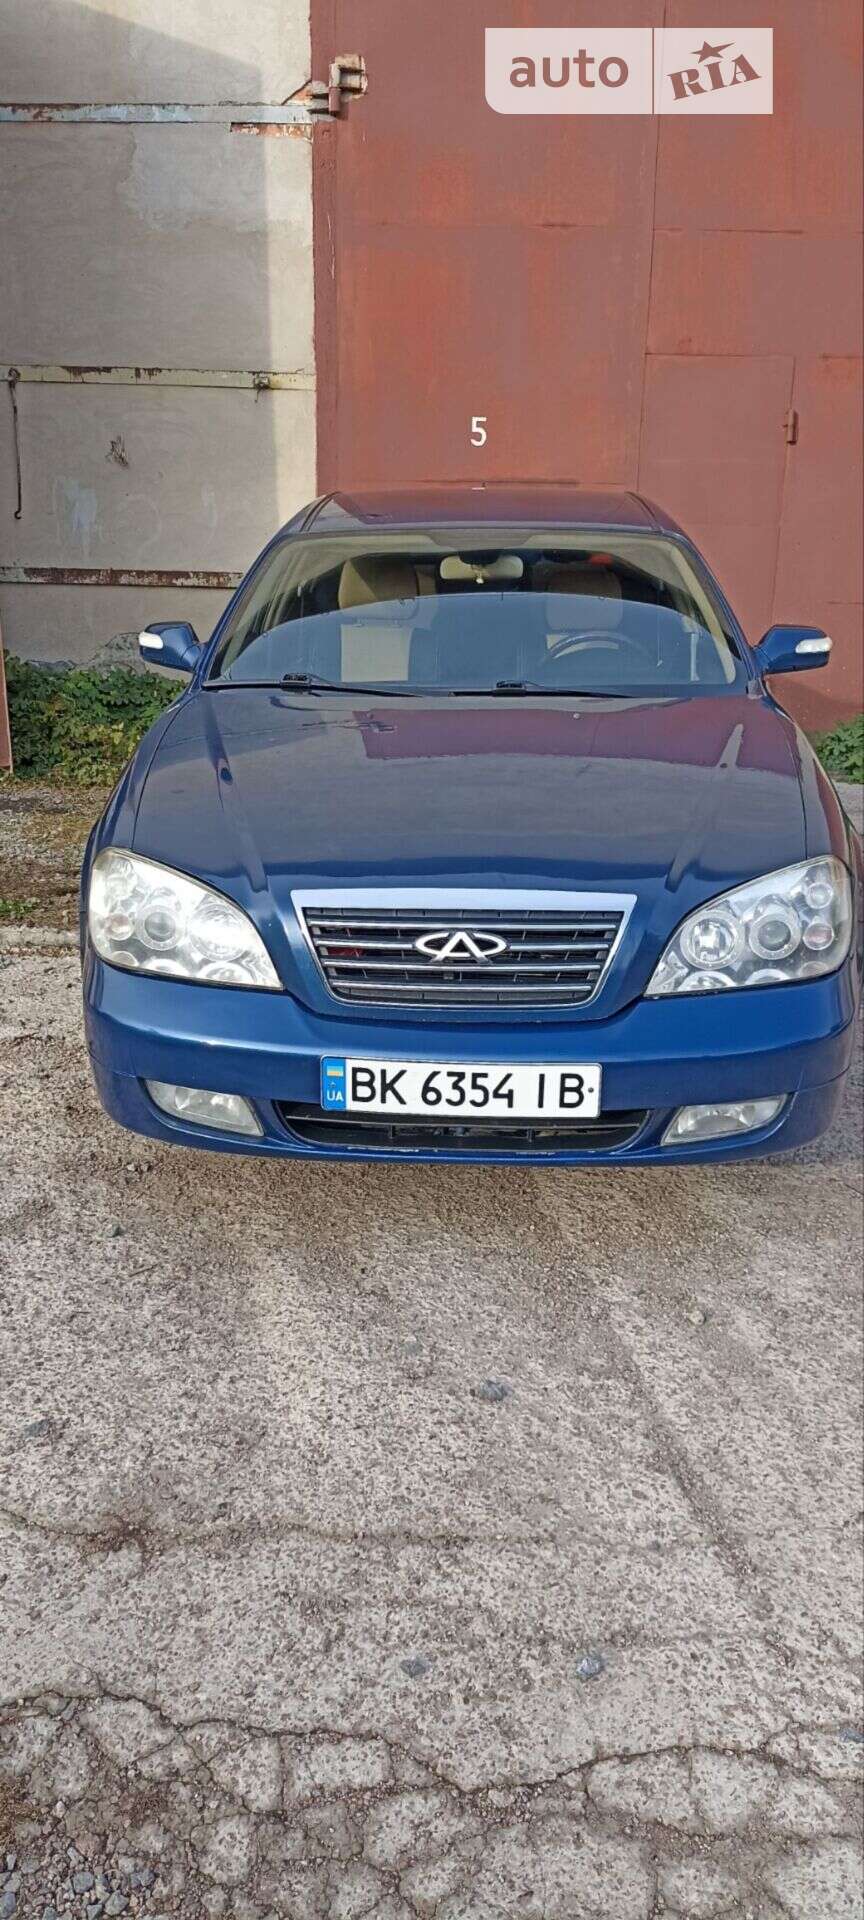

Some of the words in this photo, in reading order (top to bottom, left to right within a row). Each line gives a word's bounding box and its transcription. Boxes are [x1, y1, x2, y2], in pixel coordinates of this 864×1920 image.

[470, 416, 487, 447] 5
[326, 1090, 344, 1102] UA
[351, 1066, 407, 1105] BK
[421, 1070, 514, 1109] 6354
